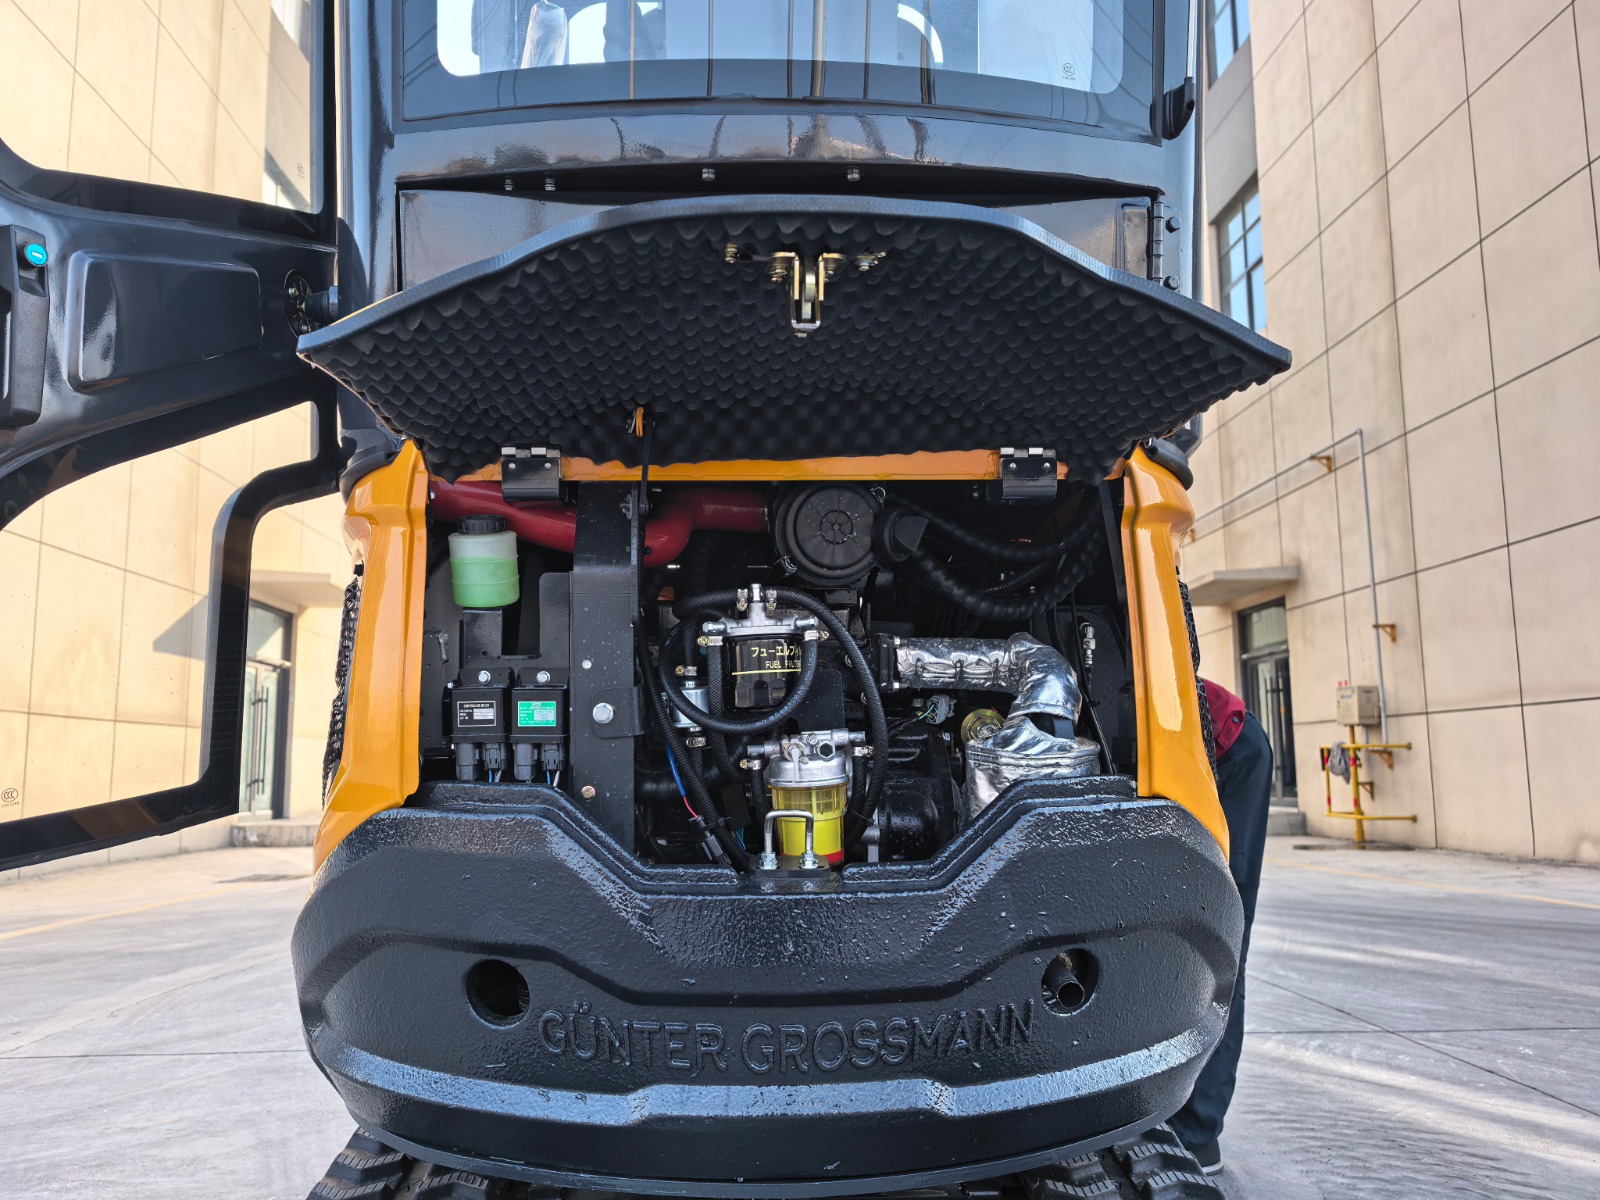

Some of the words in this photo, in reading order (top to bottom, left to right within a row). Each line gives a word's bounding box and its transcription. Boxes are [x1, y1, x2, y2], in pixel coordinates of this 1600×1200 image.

[765, 660, 782, 669] FUEL
[539, 1000, 727, 1072] GÜNTER
[741, 999, 1034, 1074] GROSSMANN
